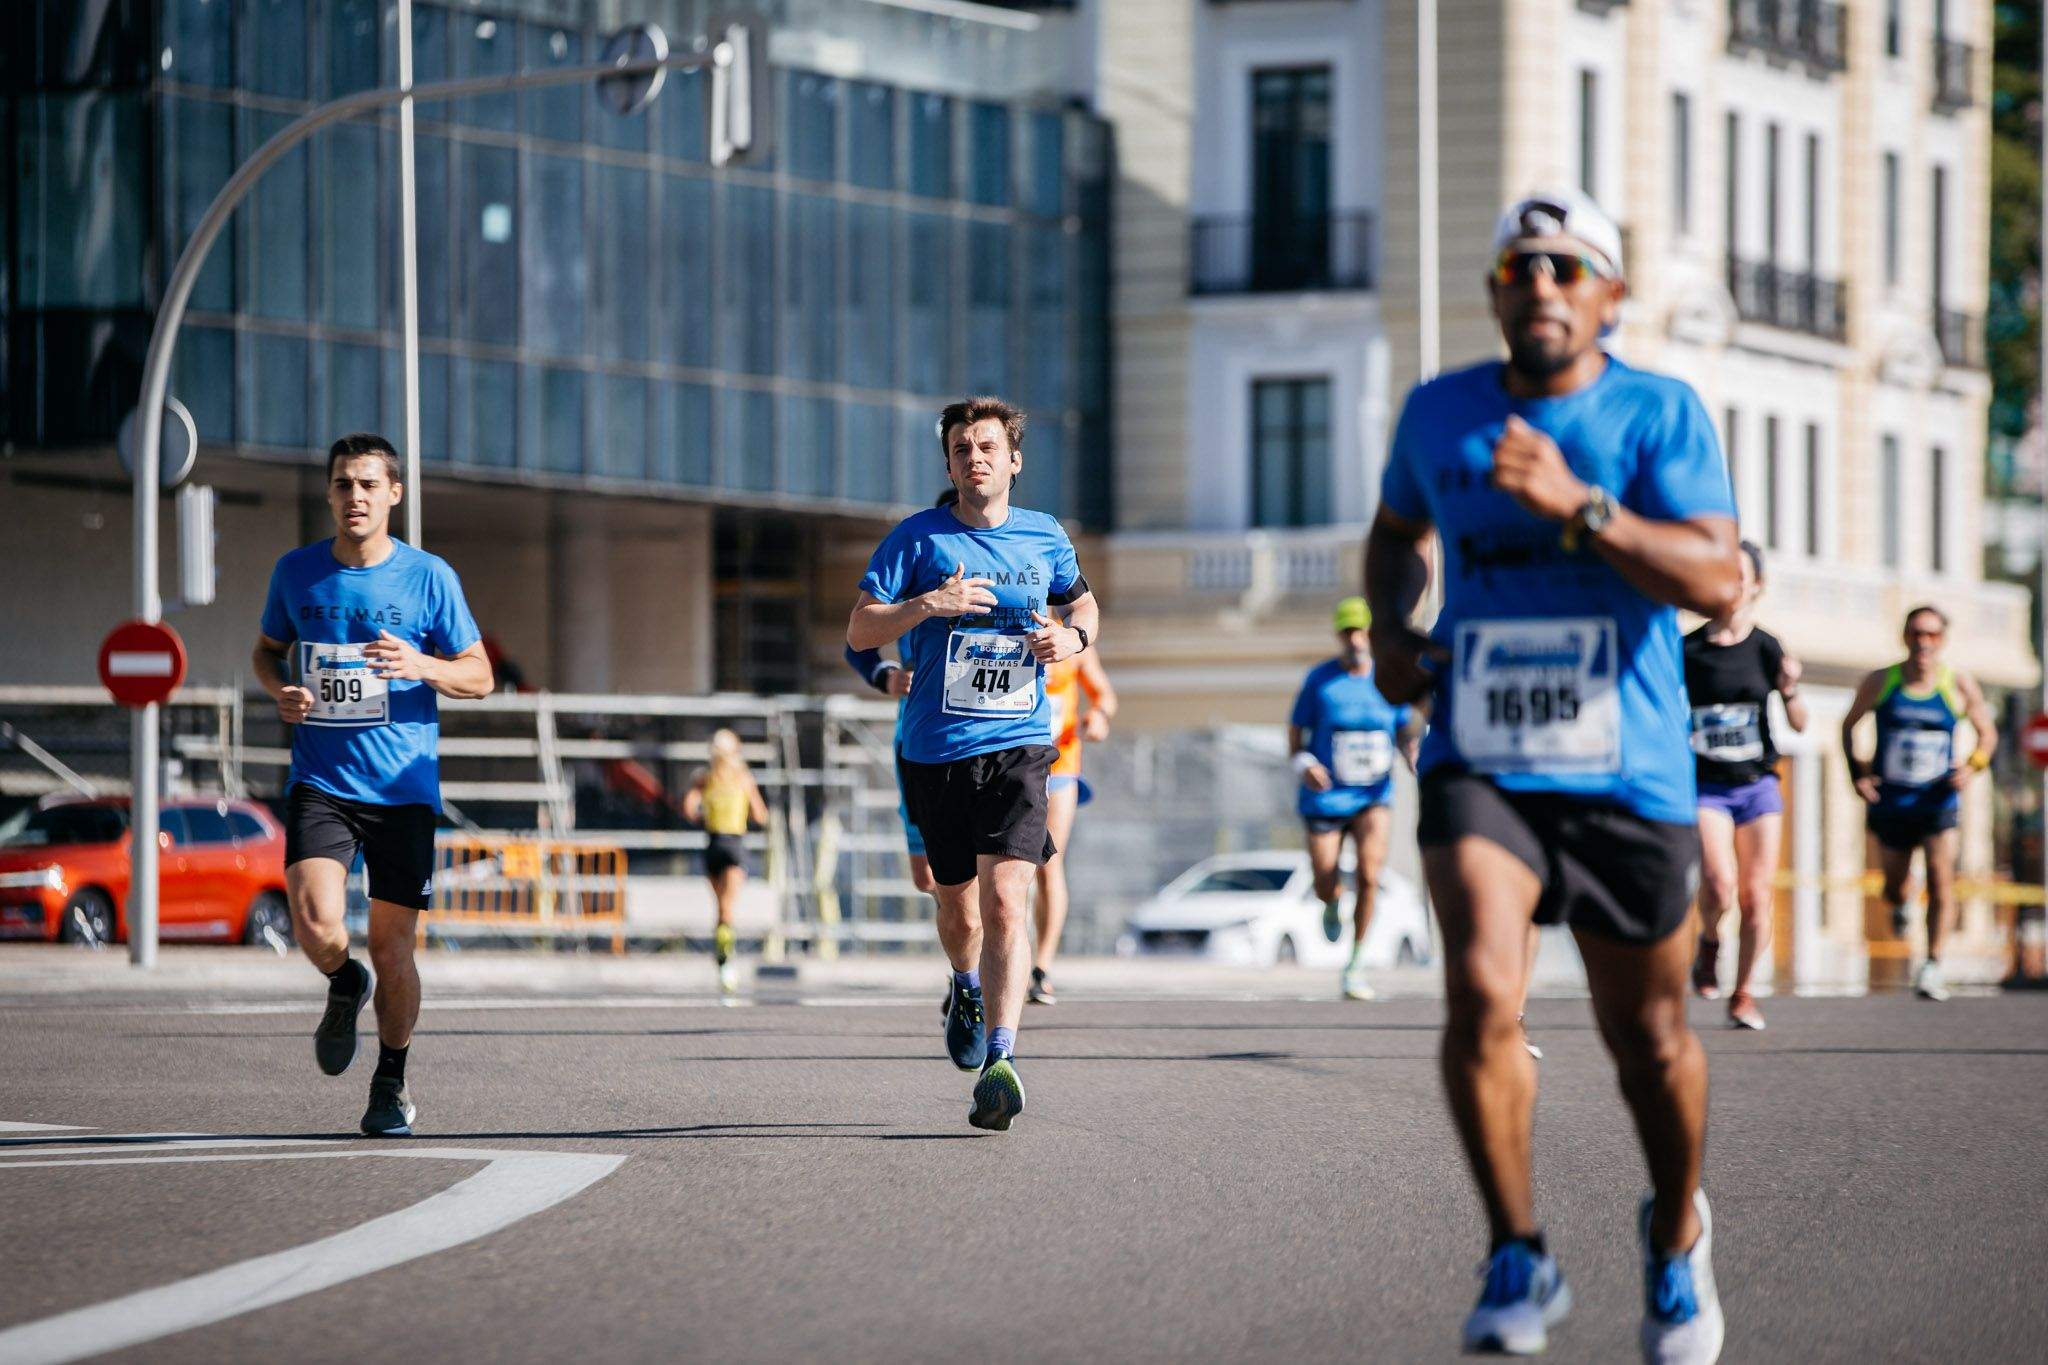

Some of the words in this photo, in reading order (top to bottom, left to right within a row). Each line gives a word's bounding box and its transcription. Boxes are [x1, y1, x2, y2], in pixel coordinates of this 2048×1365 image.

[300, 605, 402, 626] DECIMAS
[321, 669, 367, 677] DECIMAS
[973, 658, 1019, 668] DECIMAS
[320, 678, 362, 703] 509
[971, 668, 1011, 693] 474
[1487, 684, 1580, 728] 1695
